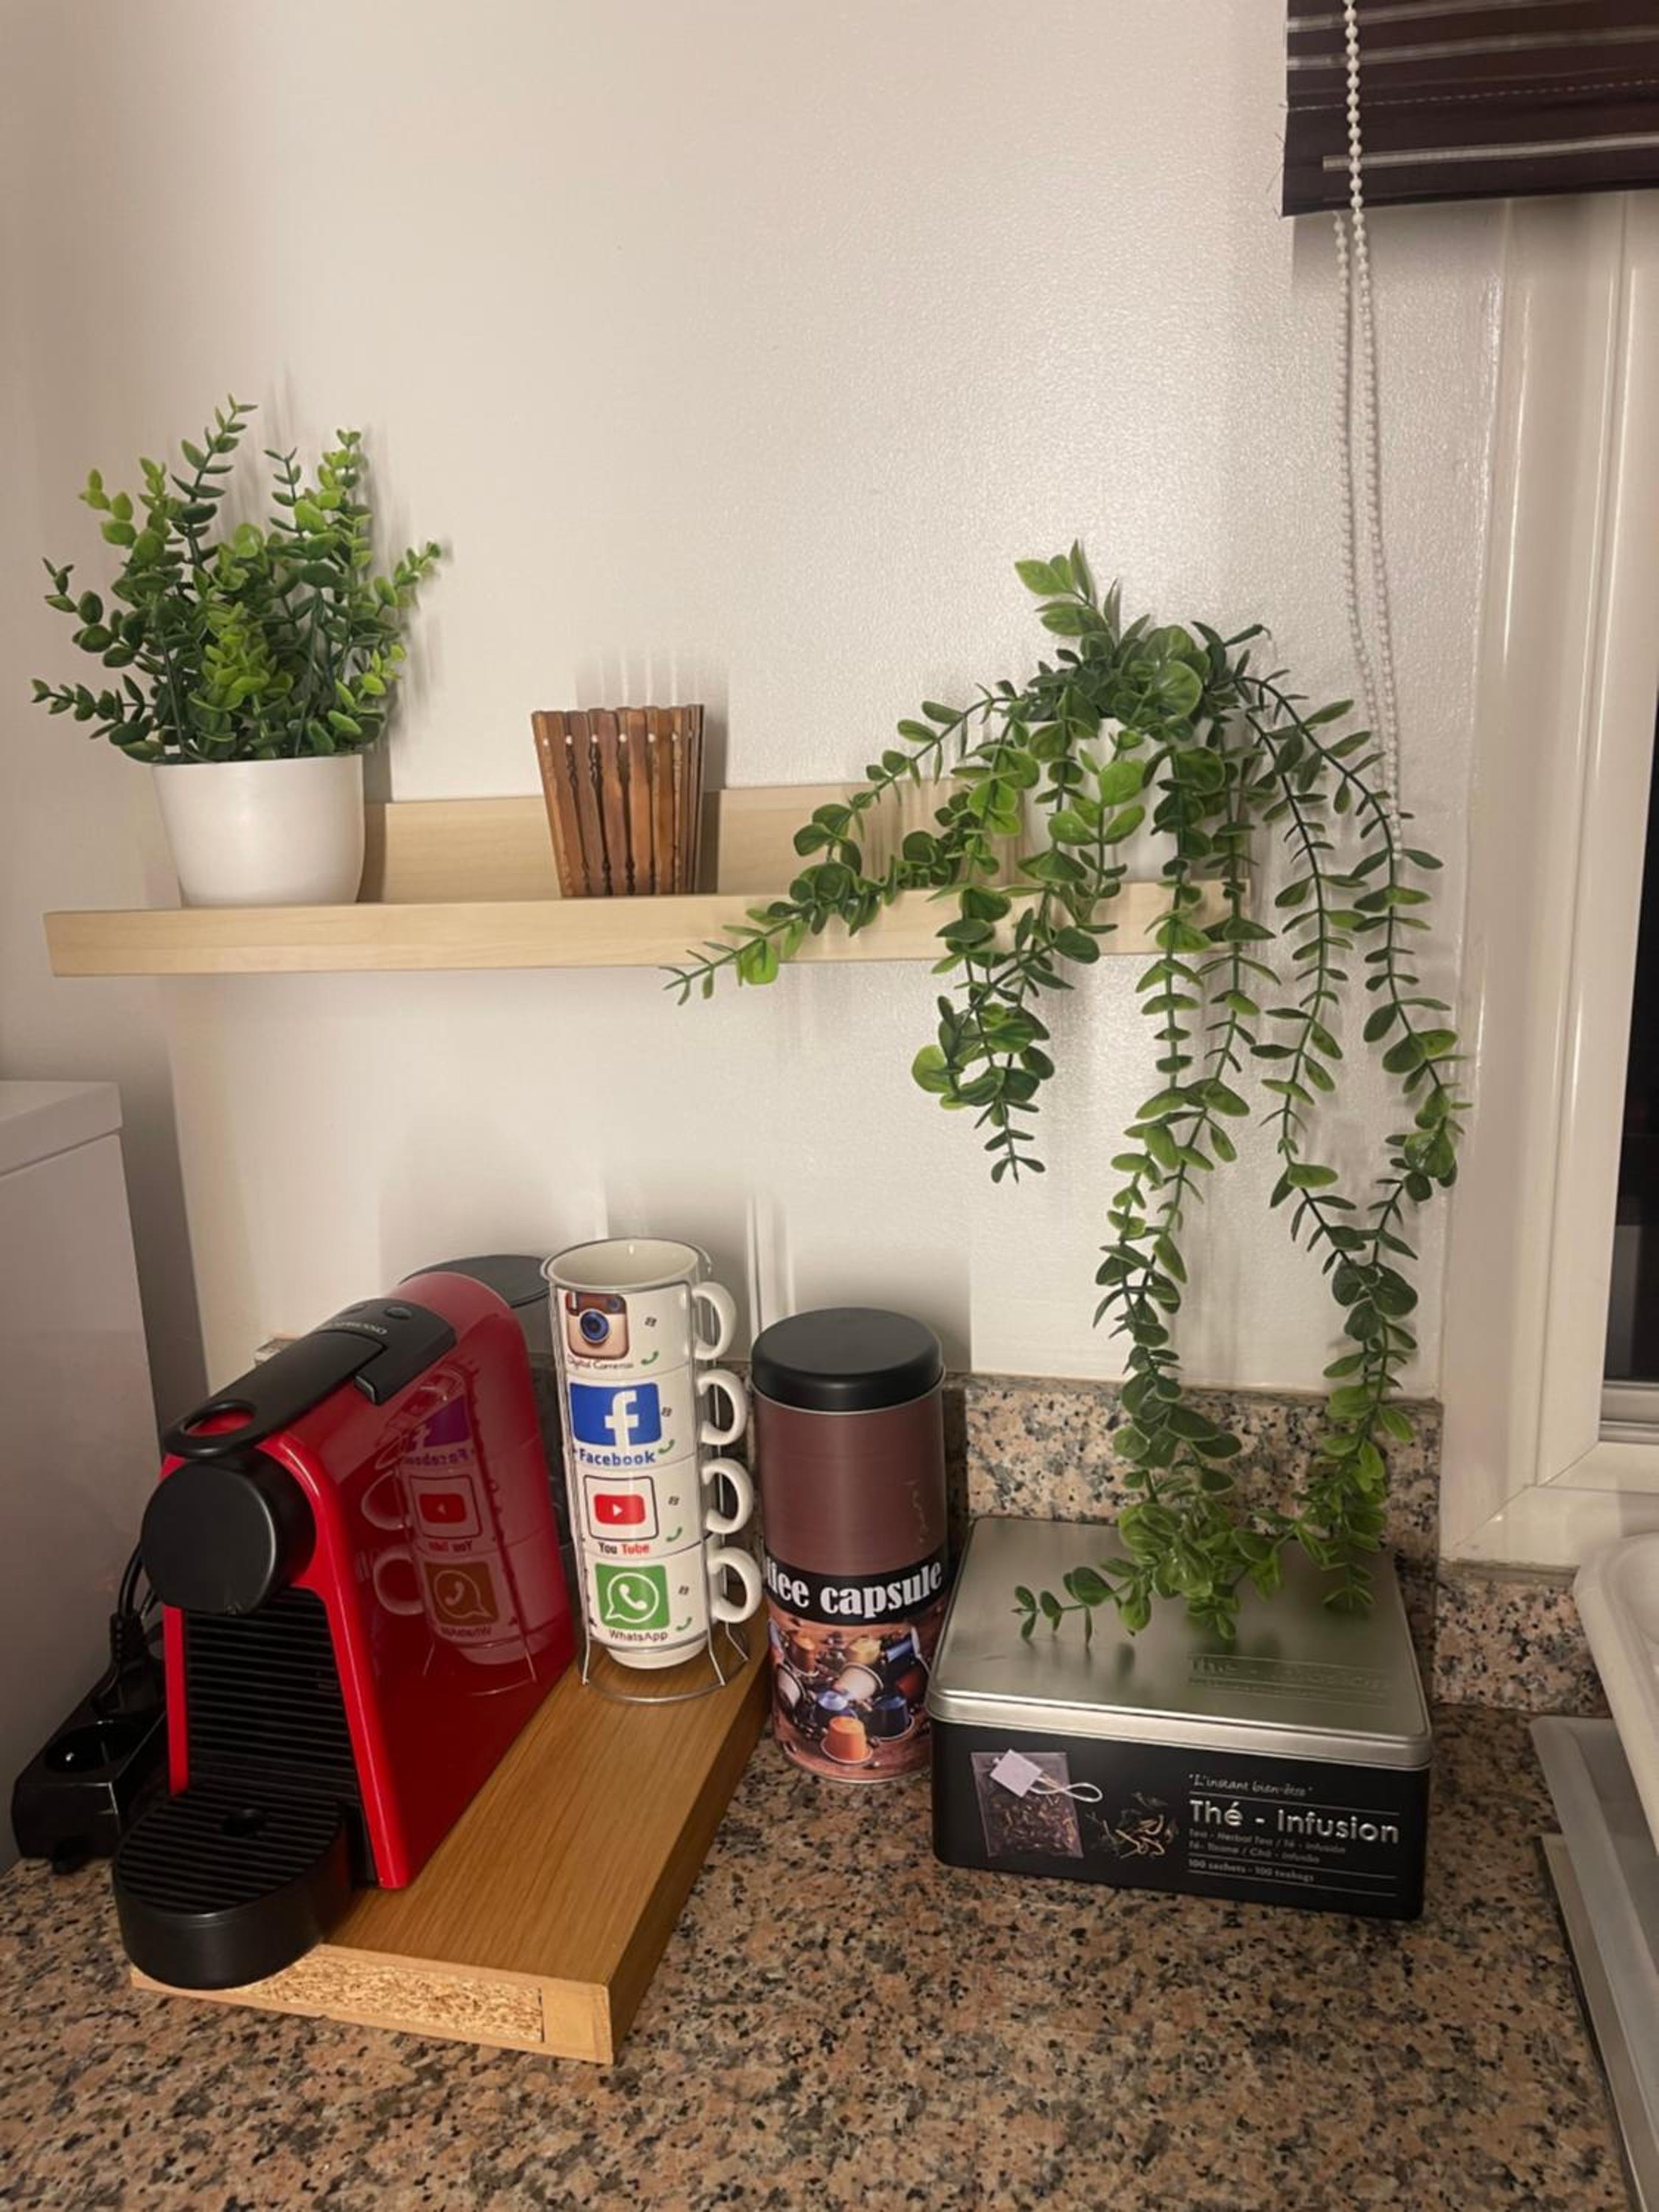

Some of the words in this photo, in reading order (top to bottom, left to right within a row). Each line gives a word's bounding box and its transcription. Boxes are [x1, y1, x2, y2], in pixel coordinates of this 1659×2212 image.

[580, 1448, 655, 1467] Facebook
[598, 1542, 617, 1554] You
[622, 1544, 650, 1556] Tube
[820, 1562, 942, 1618] capsule
[609, 1630, 668, 1641] WhatsApp
[1189, 1800, 1243, 1826] Thé
[1278, 1809, 1399, 1843] Infusion
[1189, 1859, 1206, 1869] 100
[1255, 1865, 1273, 1876] 100
